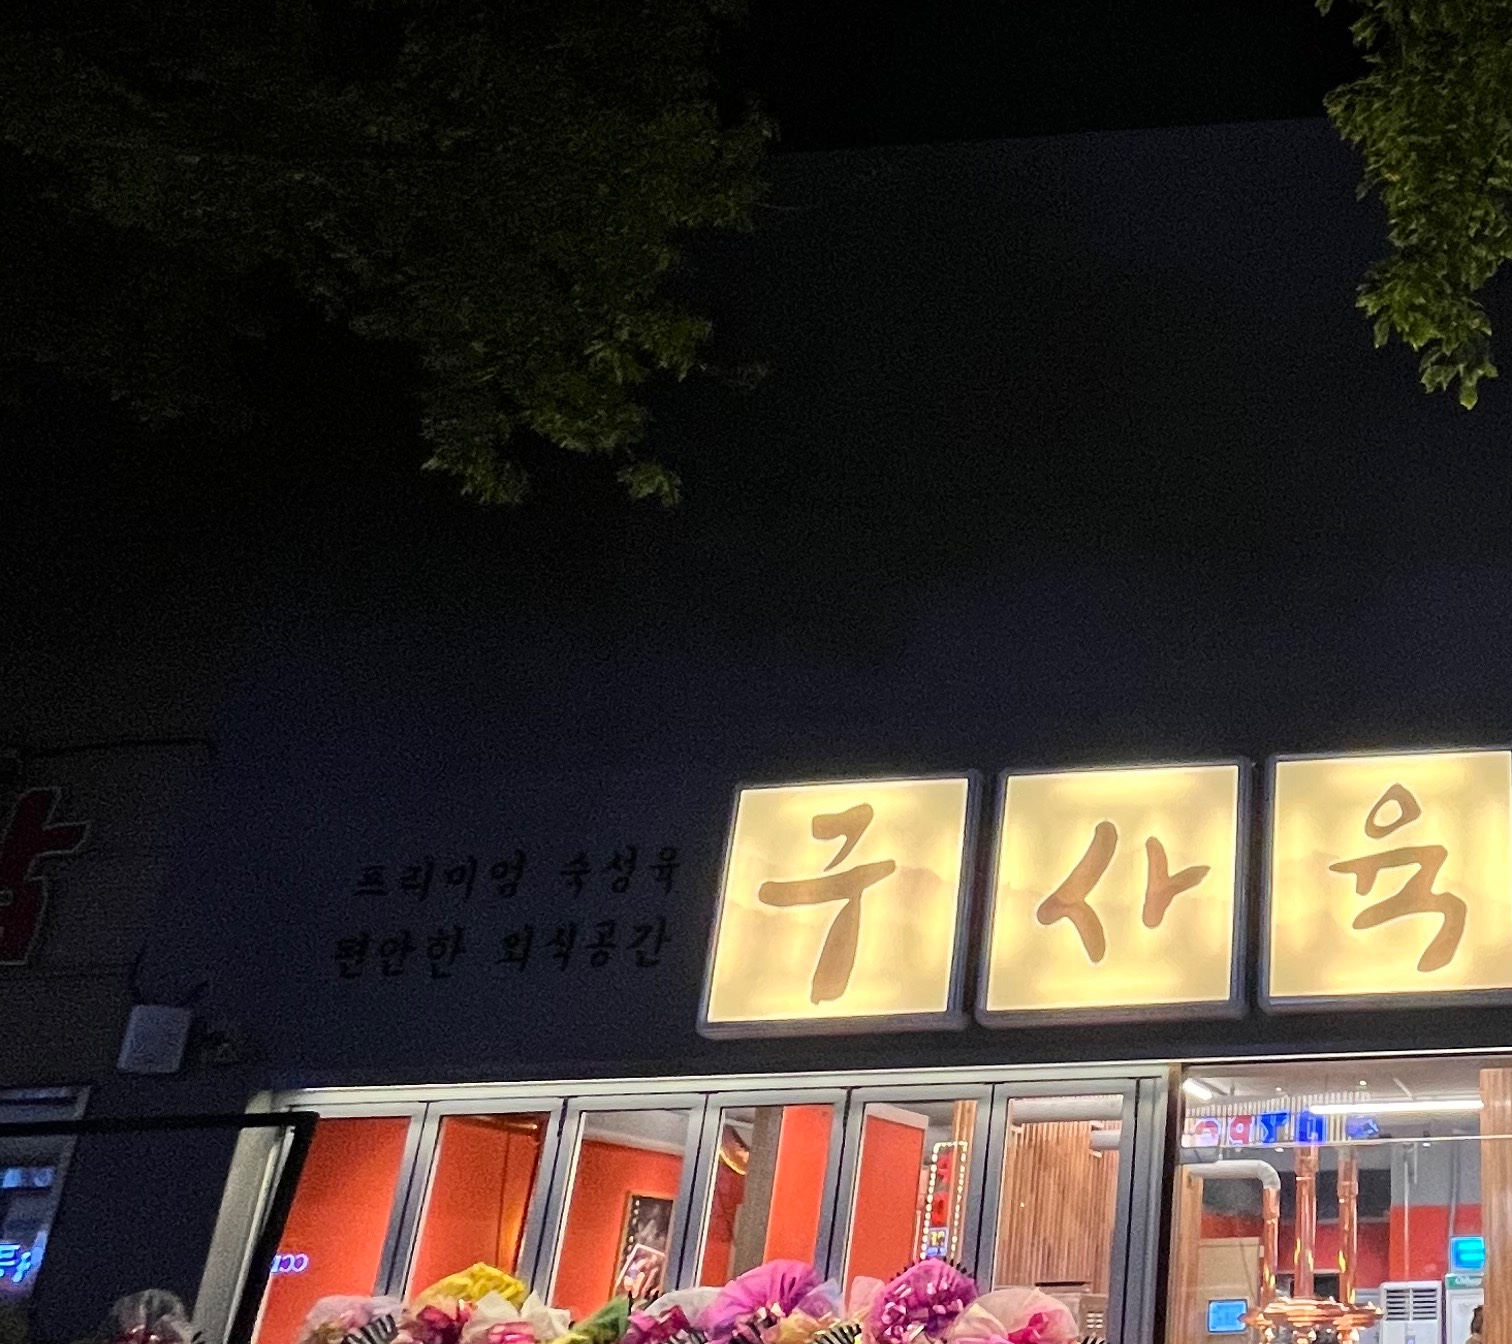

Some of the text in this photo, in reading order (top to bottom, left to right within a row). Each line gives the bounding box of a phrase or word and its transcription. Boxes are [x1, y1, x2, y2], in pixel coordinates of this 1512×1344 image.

[353, 844, 681, 903] 프리미엄 숙성육
[335, 915, 671, 980] 편안한 외식공간
